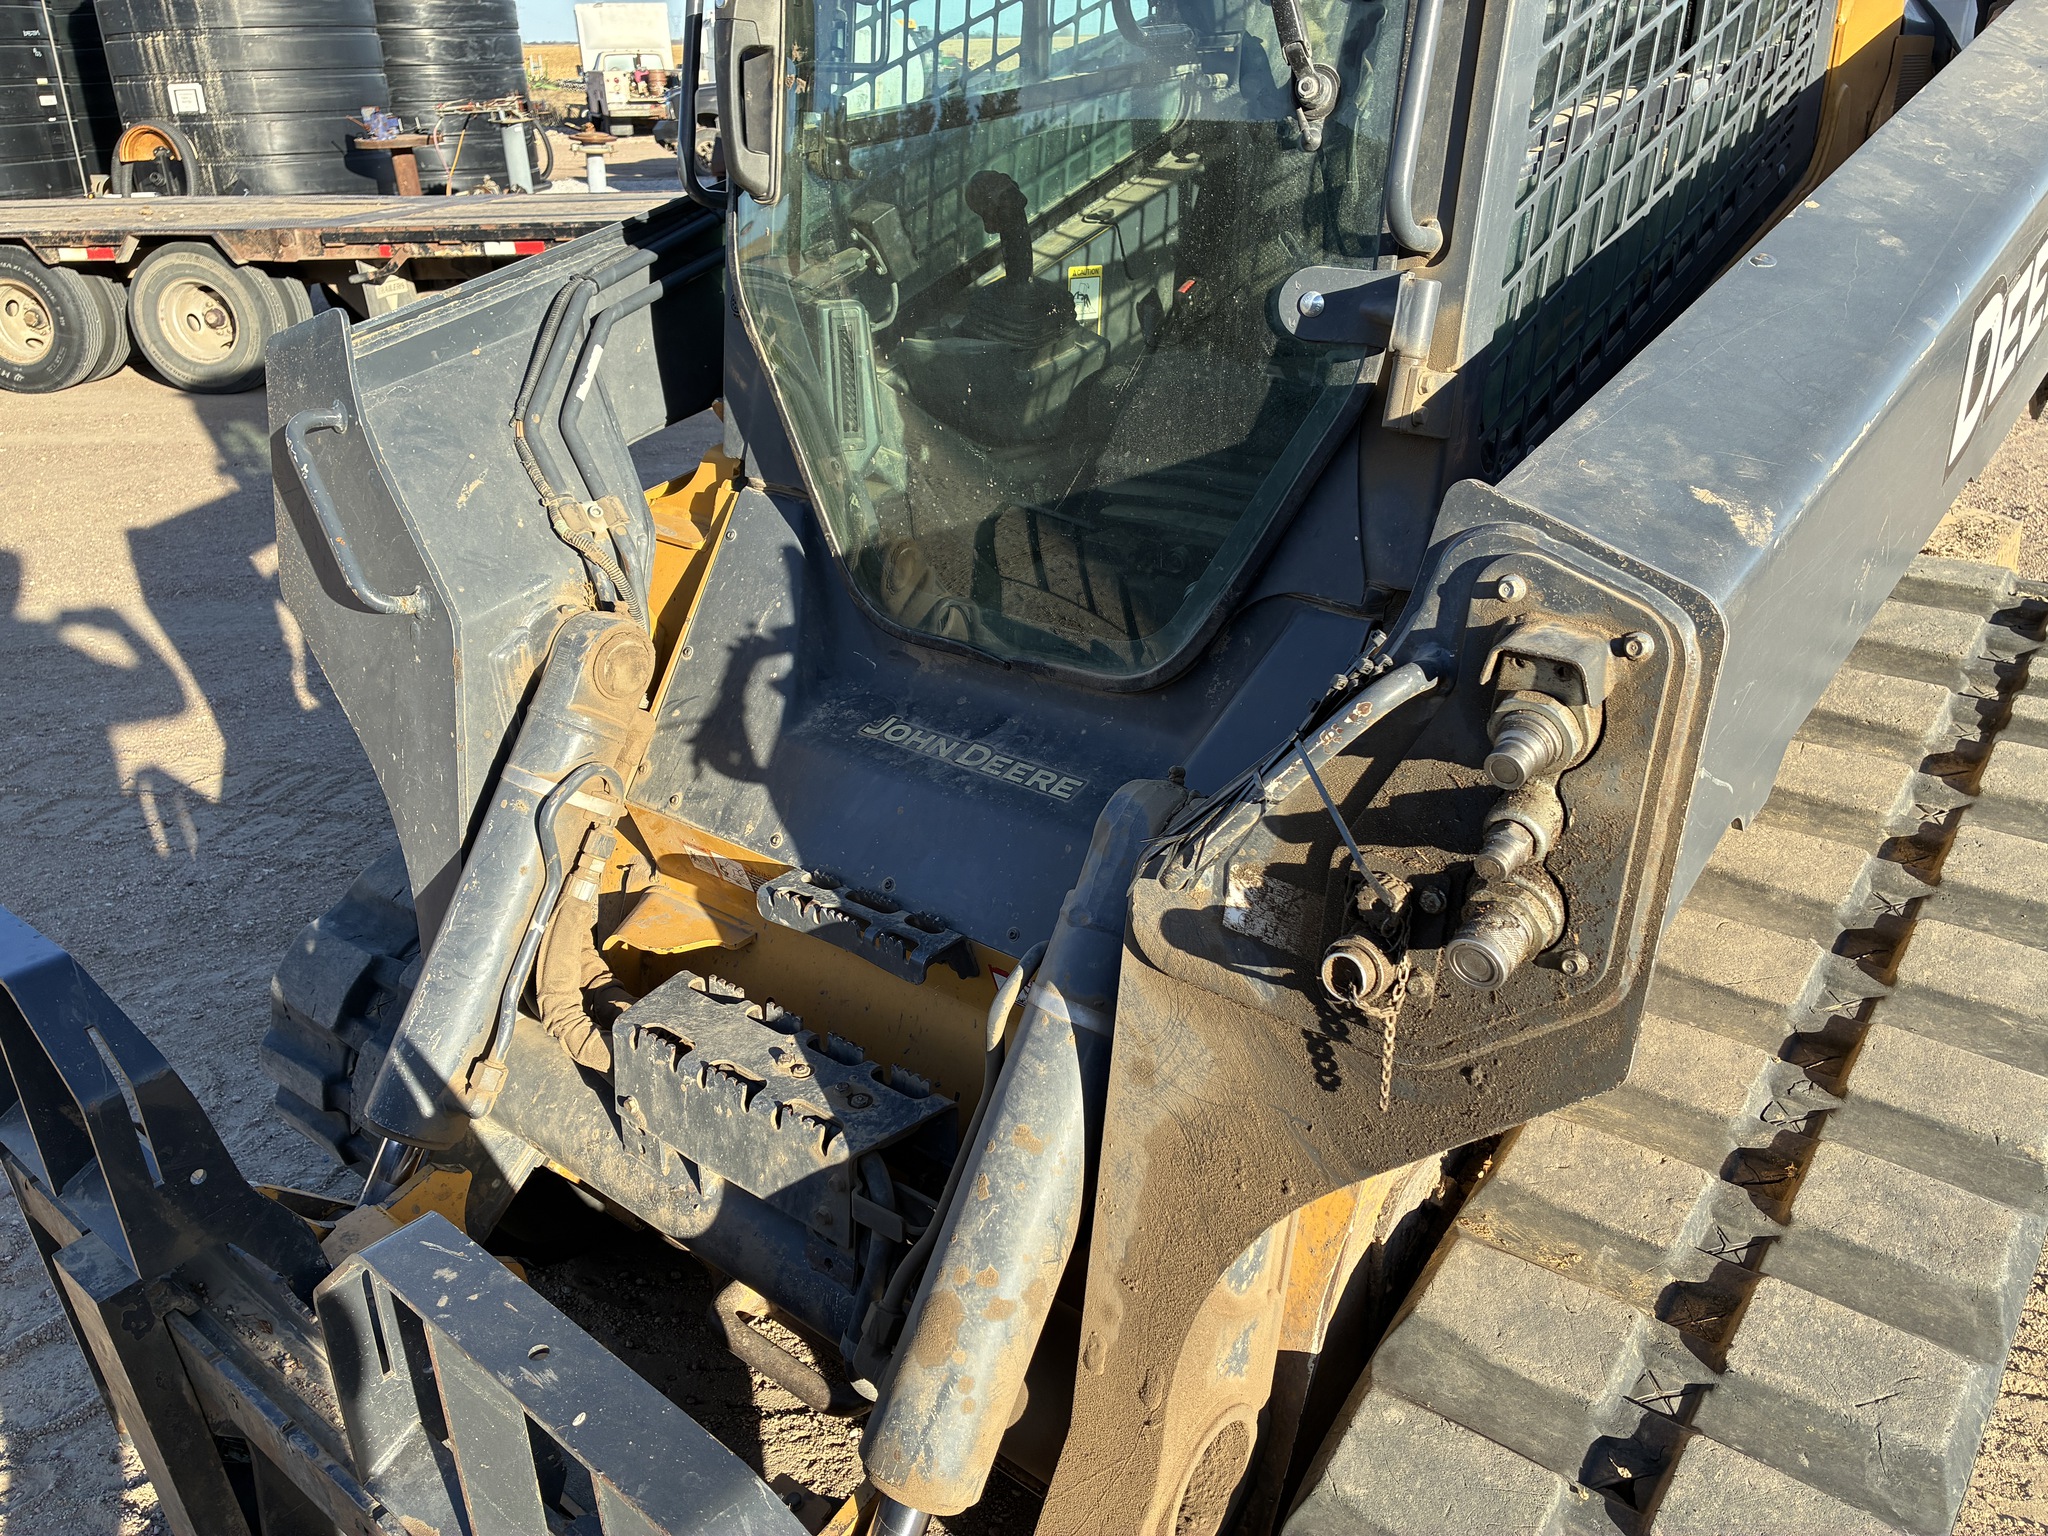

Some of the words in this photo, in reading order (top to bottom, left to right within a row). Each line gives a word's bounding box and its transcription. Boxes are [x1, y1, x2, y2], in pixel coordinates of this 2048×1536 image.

[1076, 268, 1100, 276] CAUTION
[1948, 237, 2048, 467] DEE
[862, 717, 960, 758] JOHN
[955, 743, 1084, 799] DEERE
